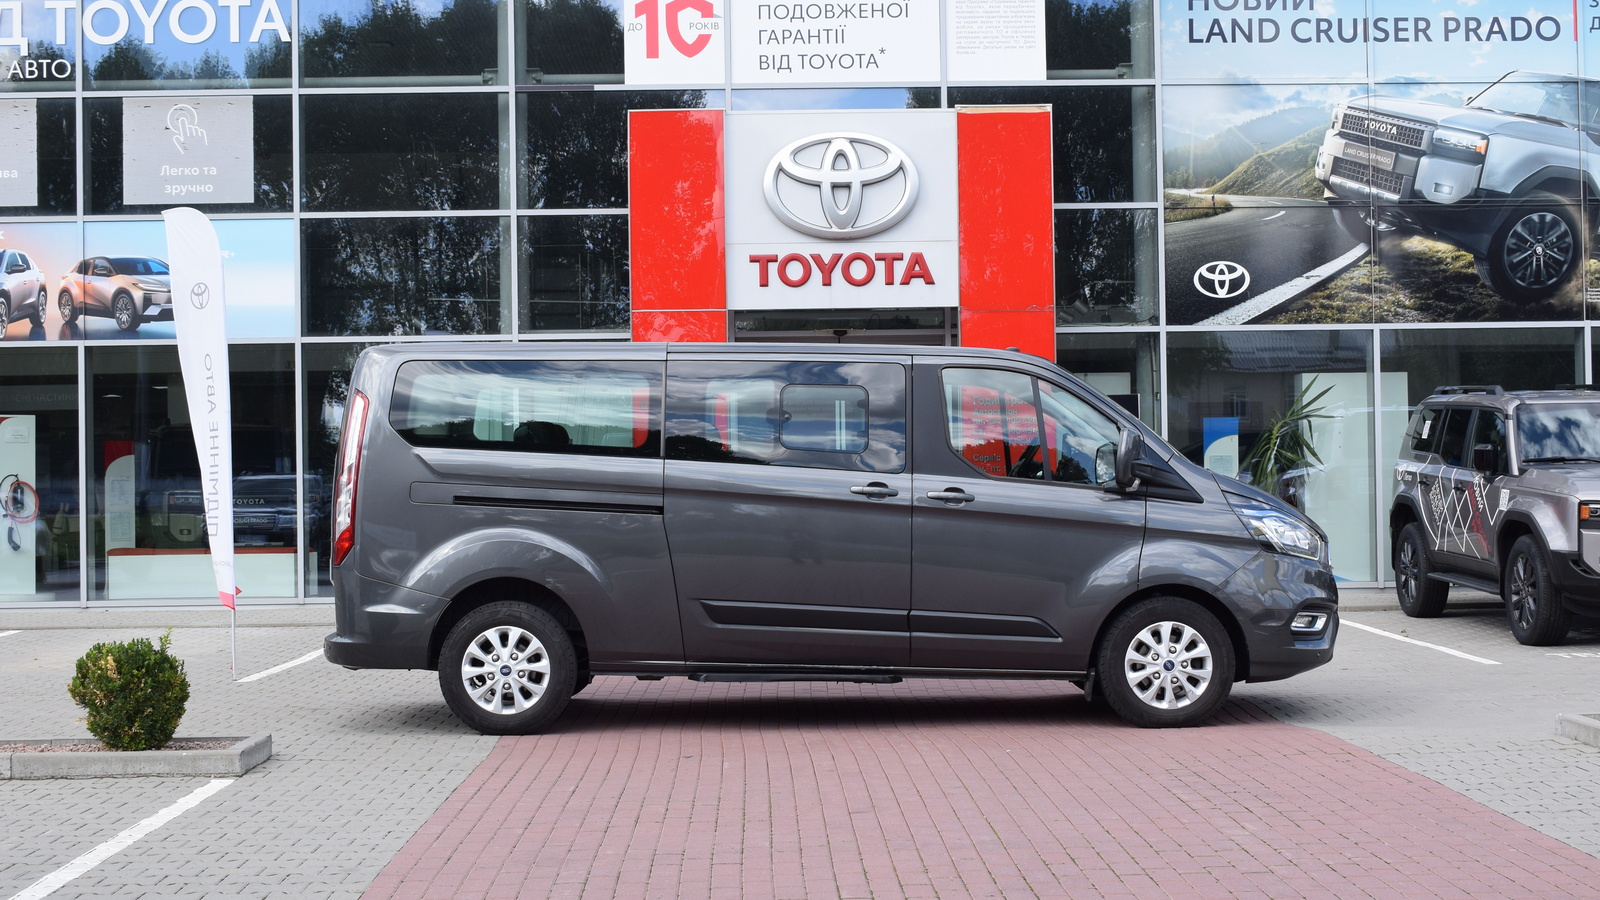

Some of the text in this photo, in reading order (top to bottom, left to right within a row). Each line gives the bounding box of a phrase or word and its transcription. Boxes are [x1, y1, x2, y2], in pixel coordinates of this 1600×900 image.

[758, 0, 911, 23] ПОДОВЖЕНОЇ
[44, 0, 292, 46] TOYOTA
[627, 22, 643, 32] ДО
[689, 22, 720, 31] РОКІВ
[1188, 16, 1562, 43] LAND CRUISER PRADO
[758, 24, 847, 45] ГАРАНТІЇ
[7, 59, 72, 79] АВТО
[759, 54, 792, 74] ВІД
[1364, 120, 1397, 135] TOYOTA
[160, 165, 217, 177] Легко та
[164, 182, 214, 196] зручно
[749, 252, 936, 288] TOYOTA
